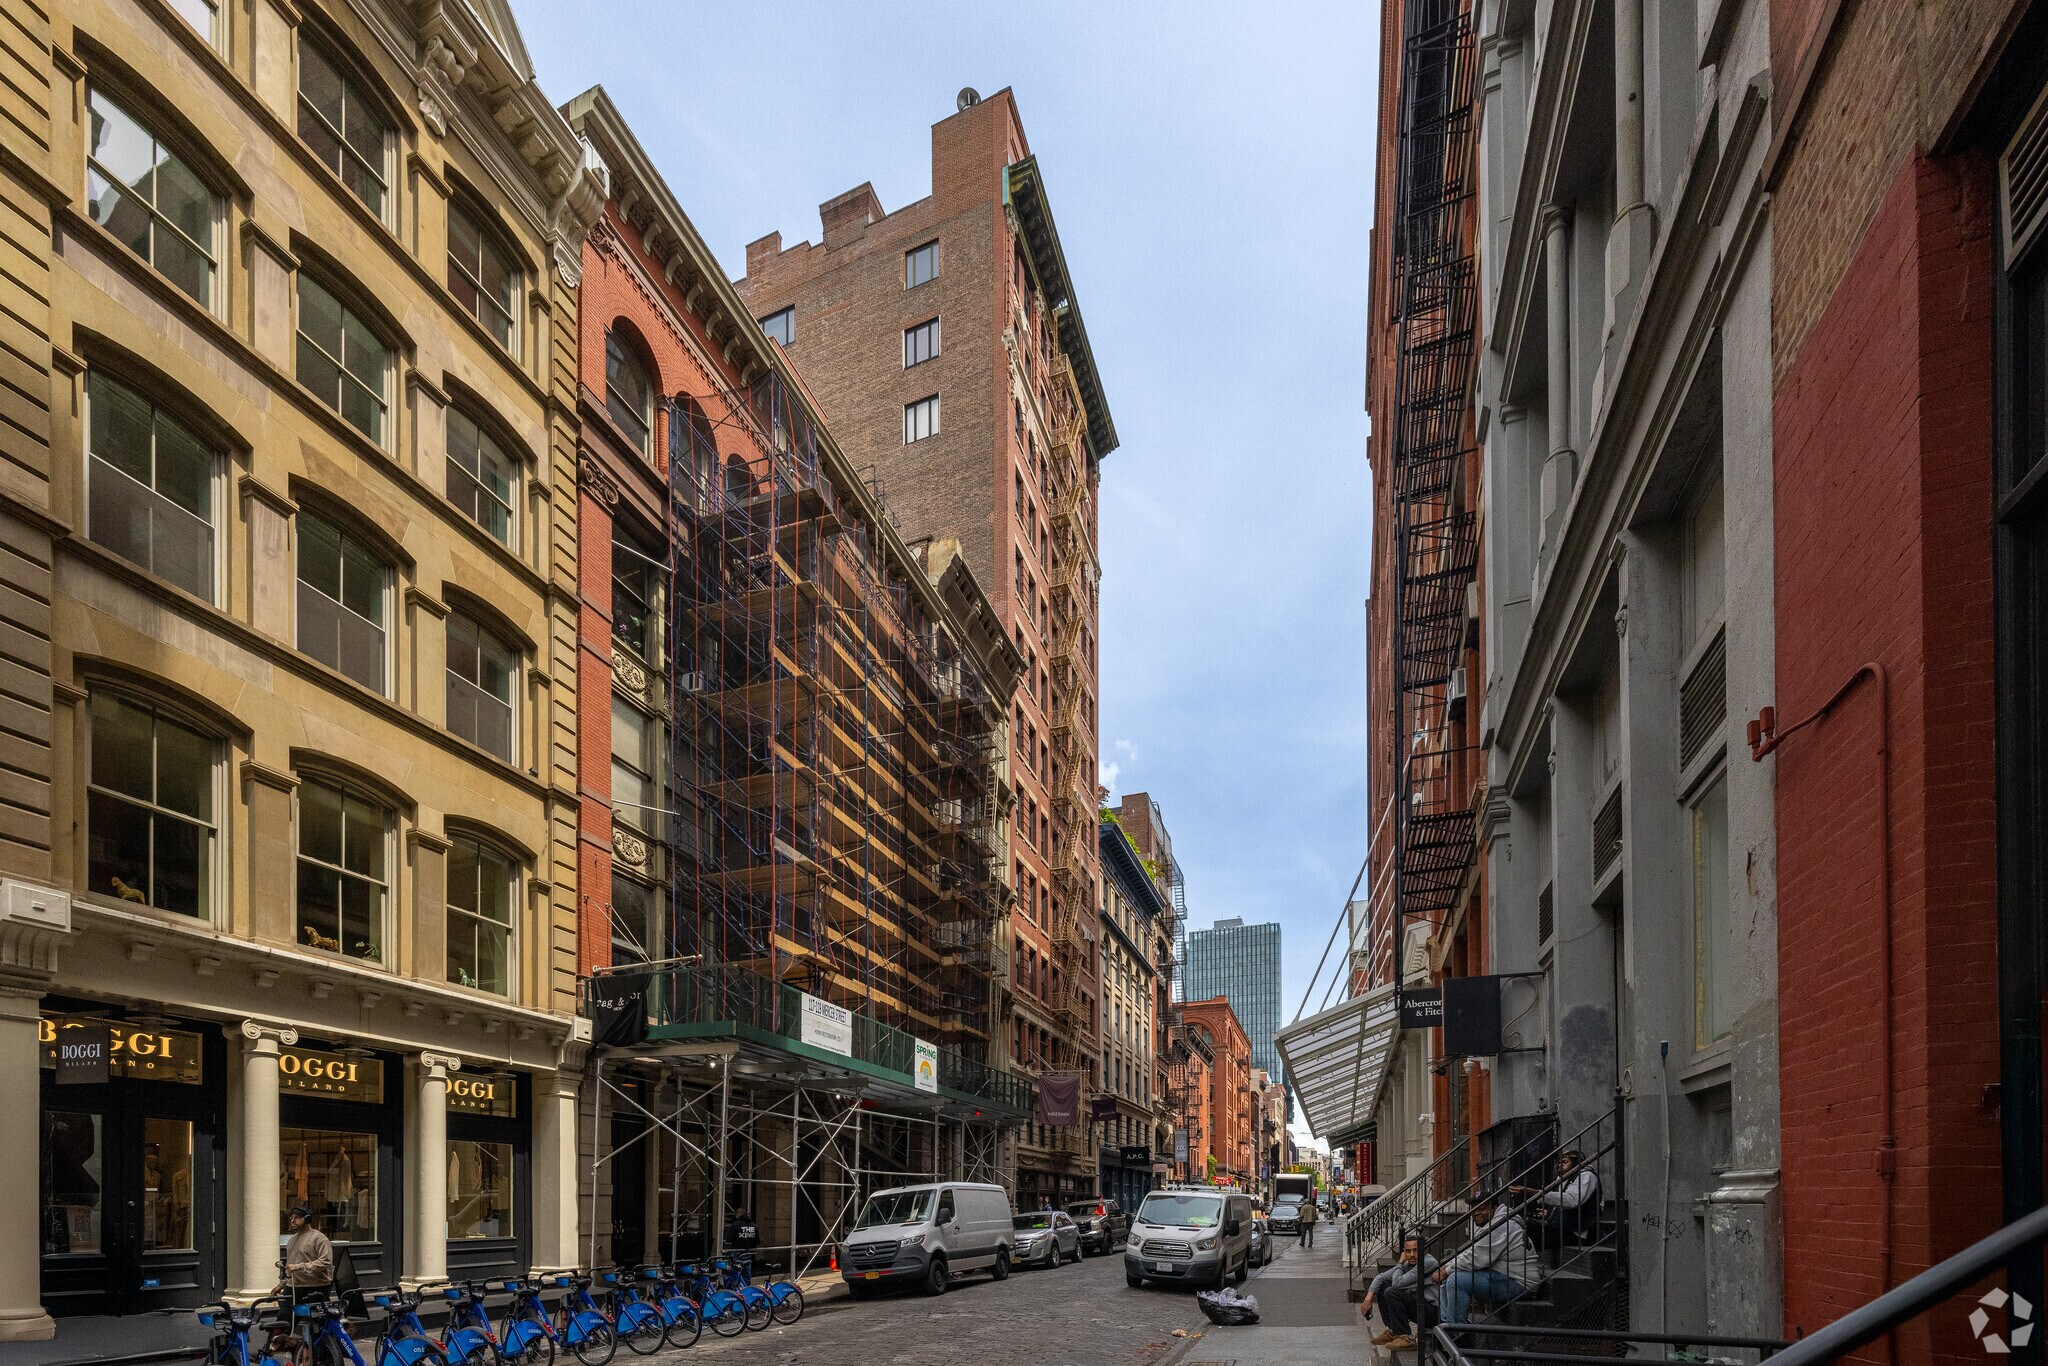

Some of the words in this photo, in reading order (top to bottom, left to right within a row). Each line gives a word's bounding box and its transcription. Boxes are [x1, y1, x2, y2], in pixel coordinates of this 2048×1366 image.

[1405, 1000, 1443, 1009] Abercro
[38, 1019, 173, 1058] BGGI
[62, 1044, 101, 1059] BOGGI
[280, 1054, 358, 1082] OGGI
[288, 1080, 345, 1092] ILANO
